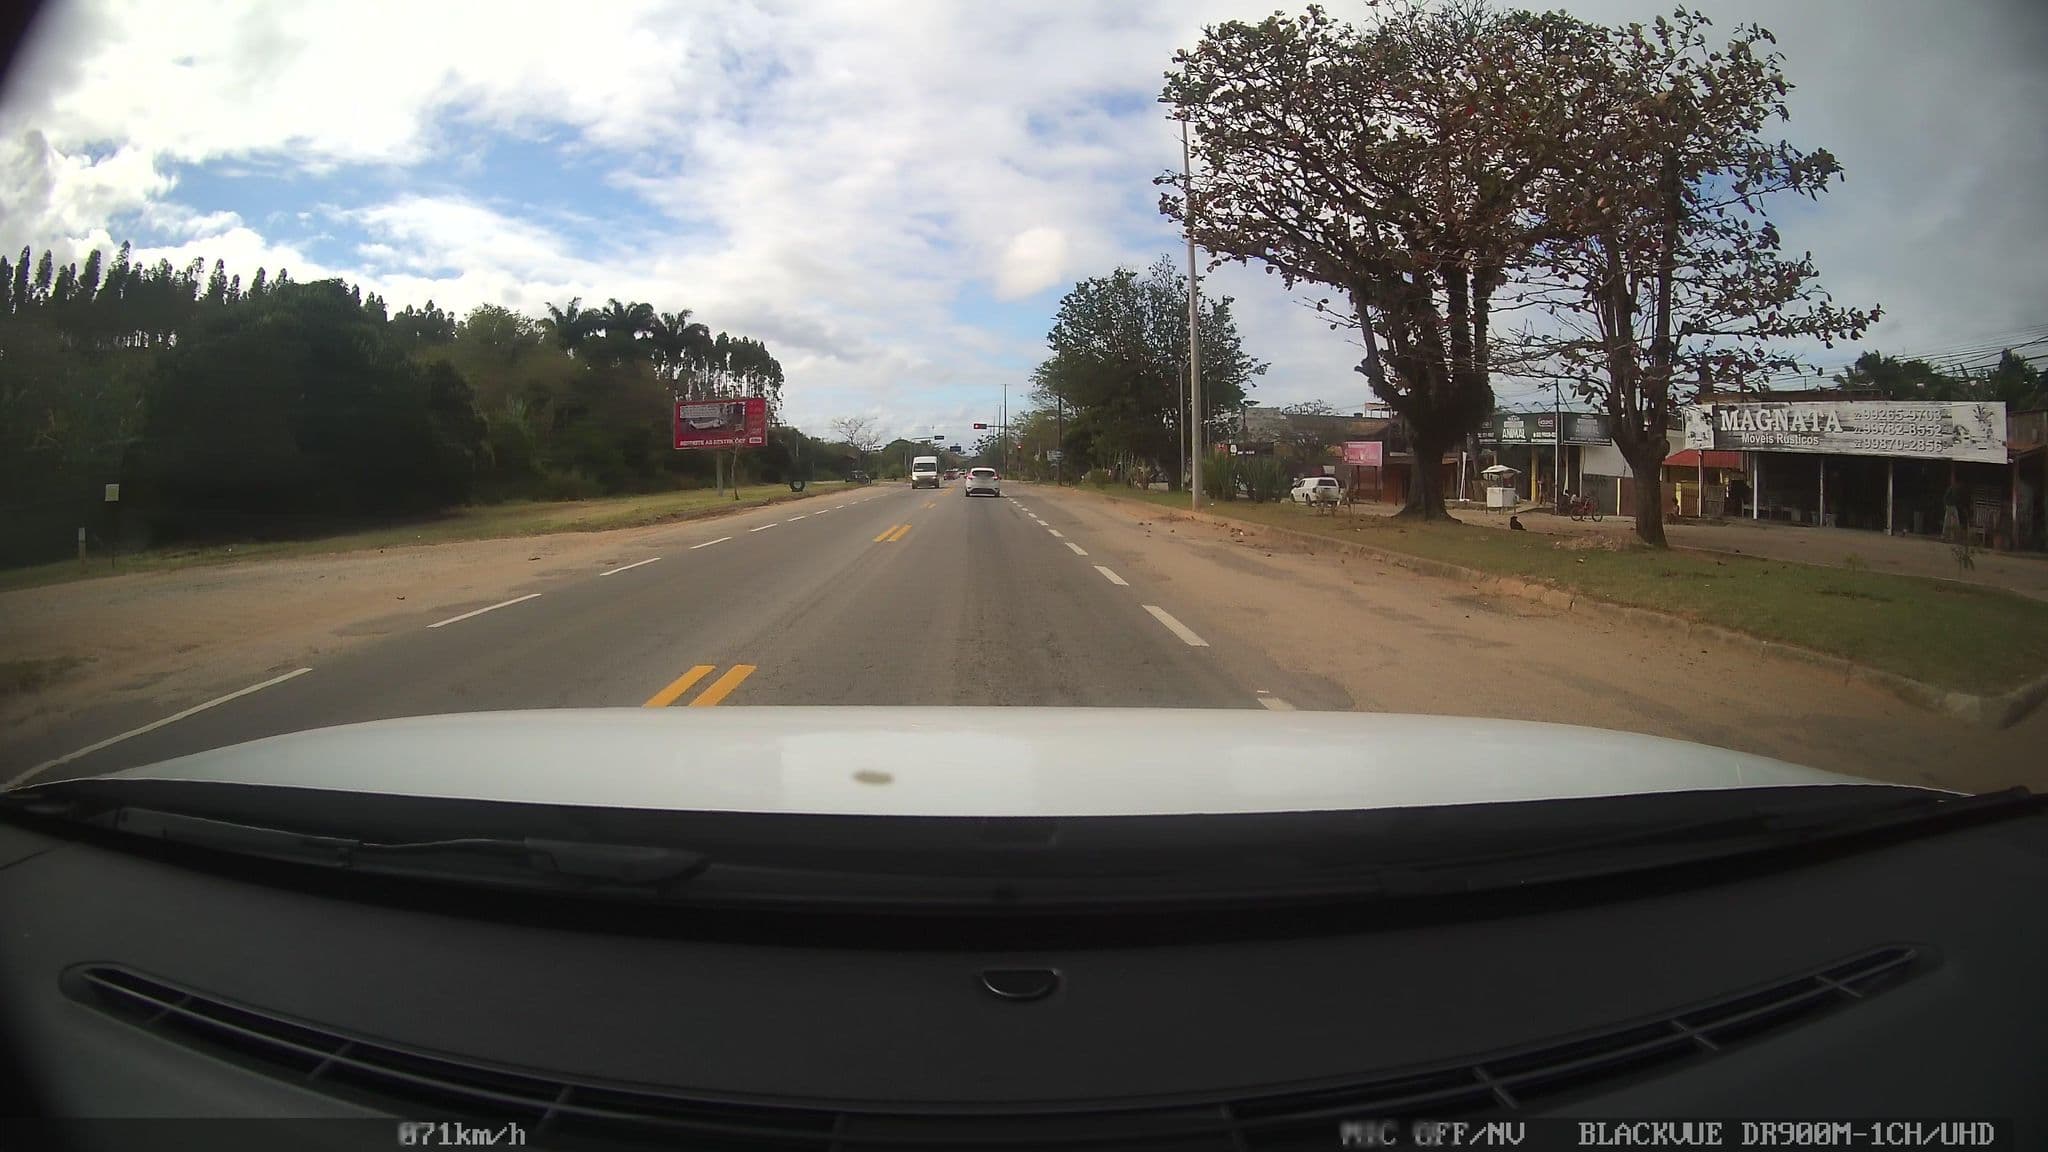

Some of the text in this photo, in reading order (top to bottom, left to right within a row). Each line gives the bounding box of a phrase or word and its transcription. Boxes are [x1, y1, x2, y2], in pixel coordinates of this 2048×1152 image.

[1720, 408, 1843, 432] MAGNATA
[1742, 432, 1819, 445] Móveis Rústicos
